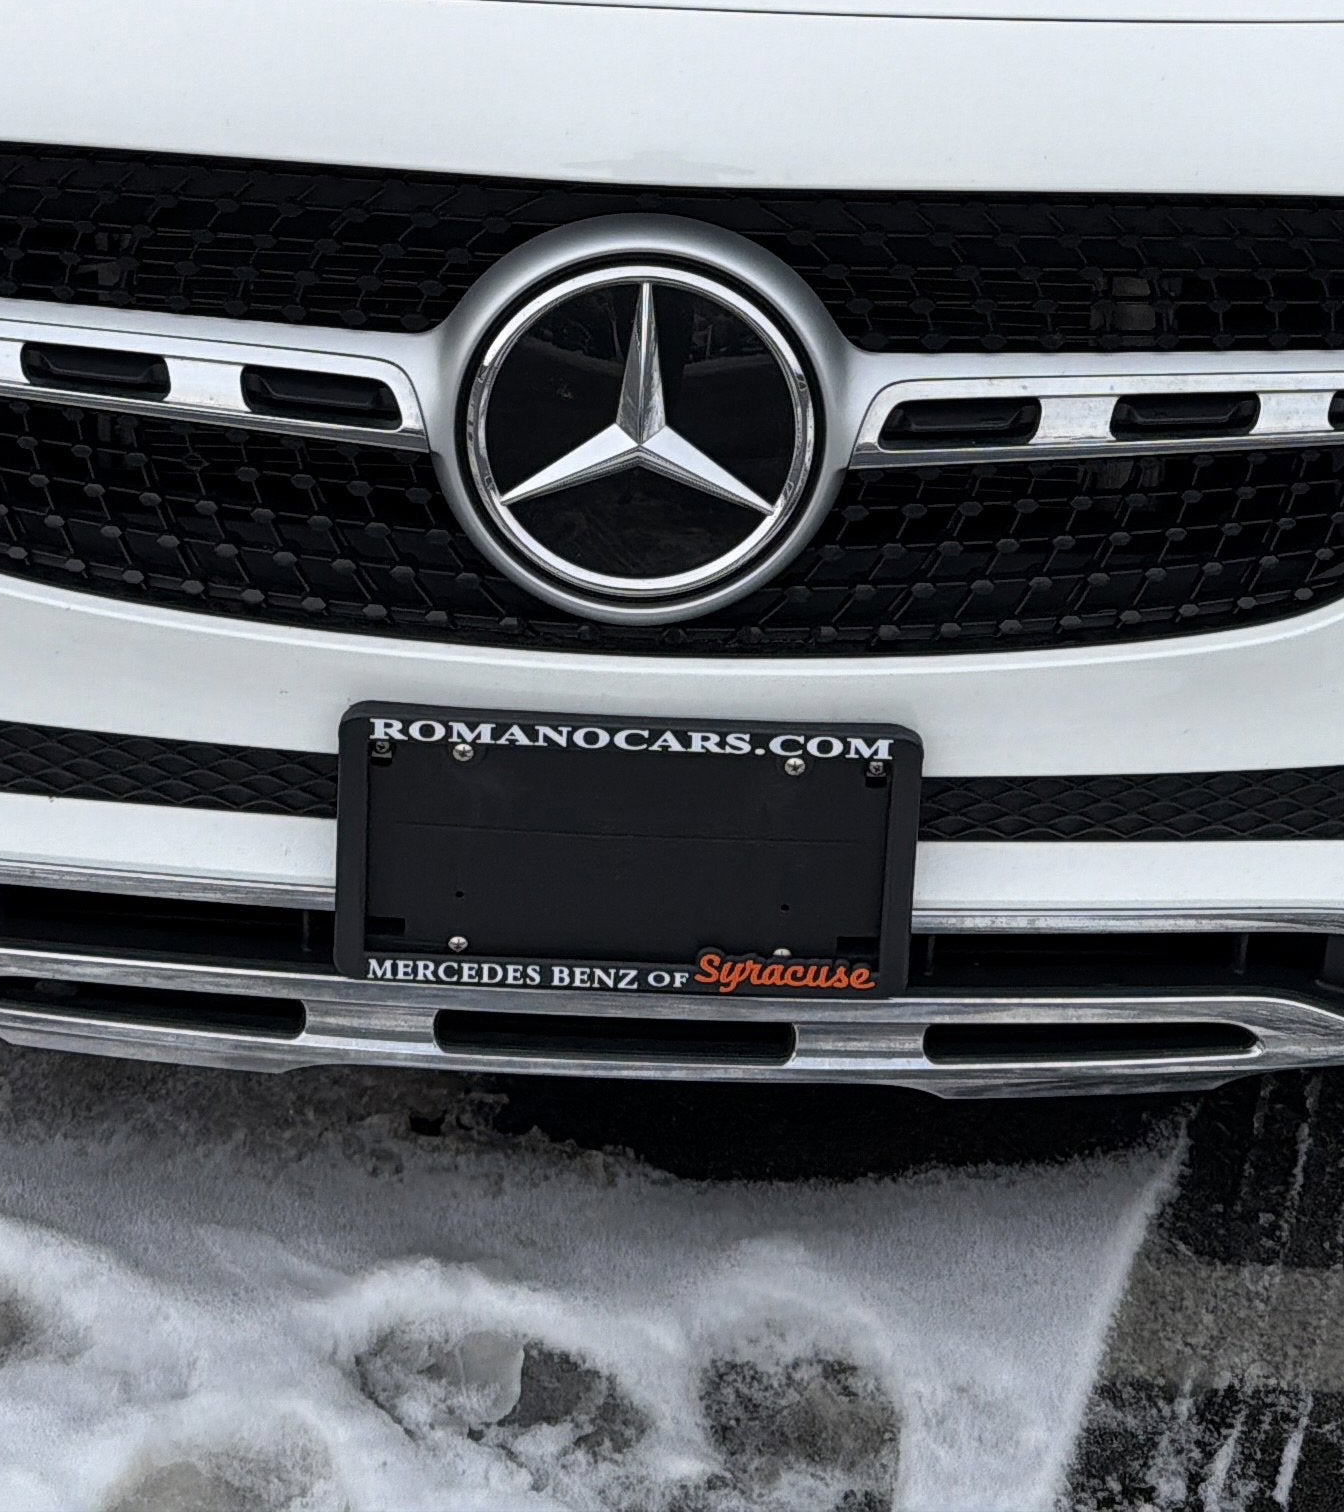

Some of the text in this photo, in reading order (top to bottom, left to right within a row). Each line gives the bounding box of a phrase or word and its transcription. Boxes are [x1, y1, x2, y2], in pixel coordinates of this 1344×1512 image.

[369, 717, 894, 761] ROMANOCARS.COM
[367, 953, 876, 994] MERCEDES BENZ OF Syracuse
